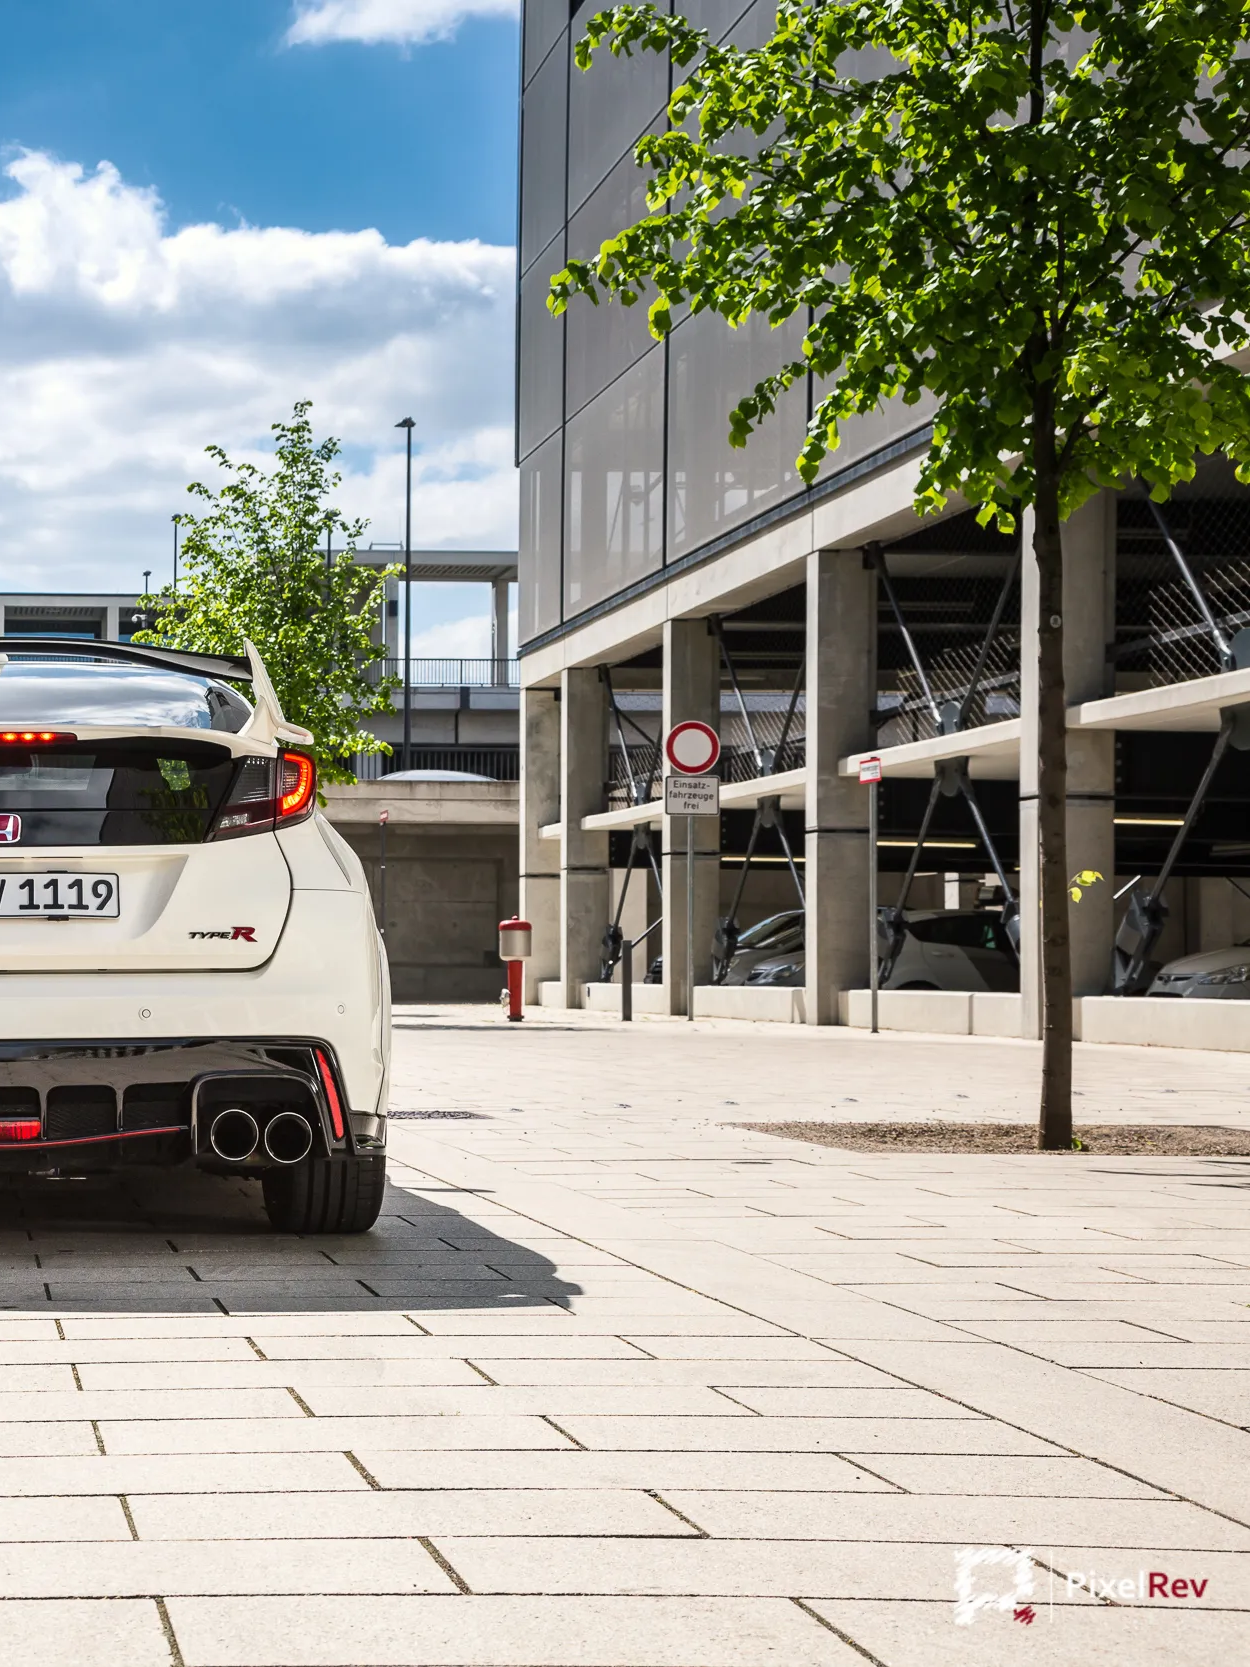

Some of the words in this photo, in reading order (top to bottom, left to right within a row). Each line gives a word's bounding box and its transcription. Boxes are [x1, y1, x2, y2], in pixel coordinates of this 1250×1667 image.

[673, 780, 710, 789] Einsatz-
[669, 790, 714, 801] fahrzeuge
[683, 801, 700, 810] frei
[18, 878, 114, 911] 1119
